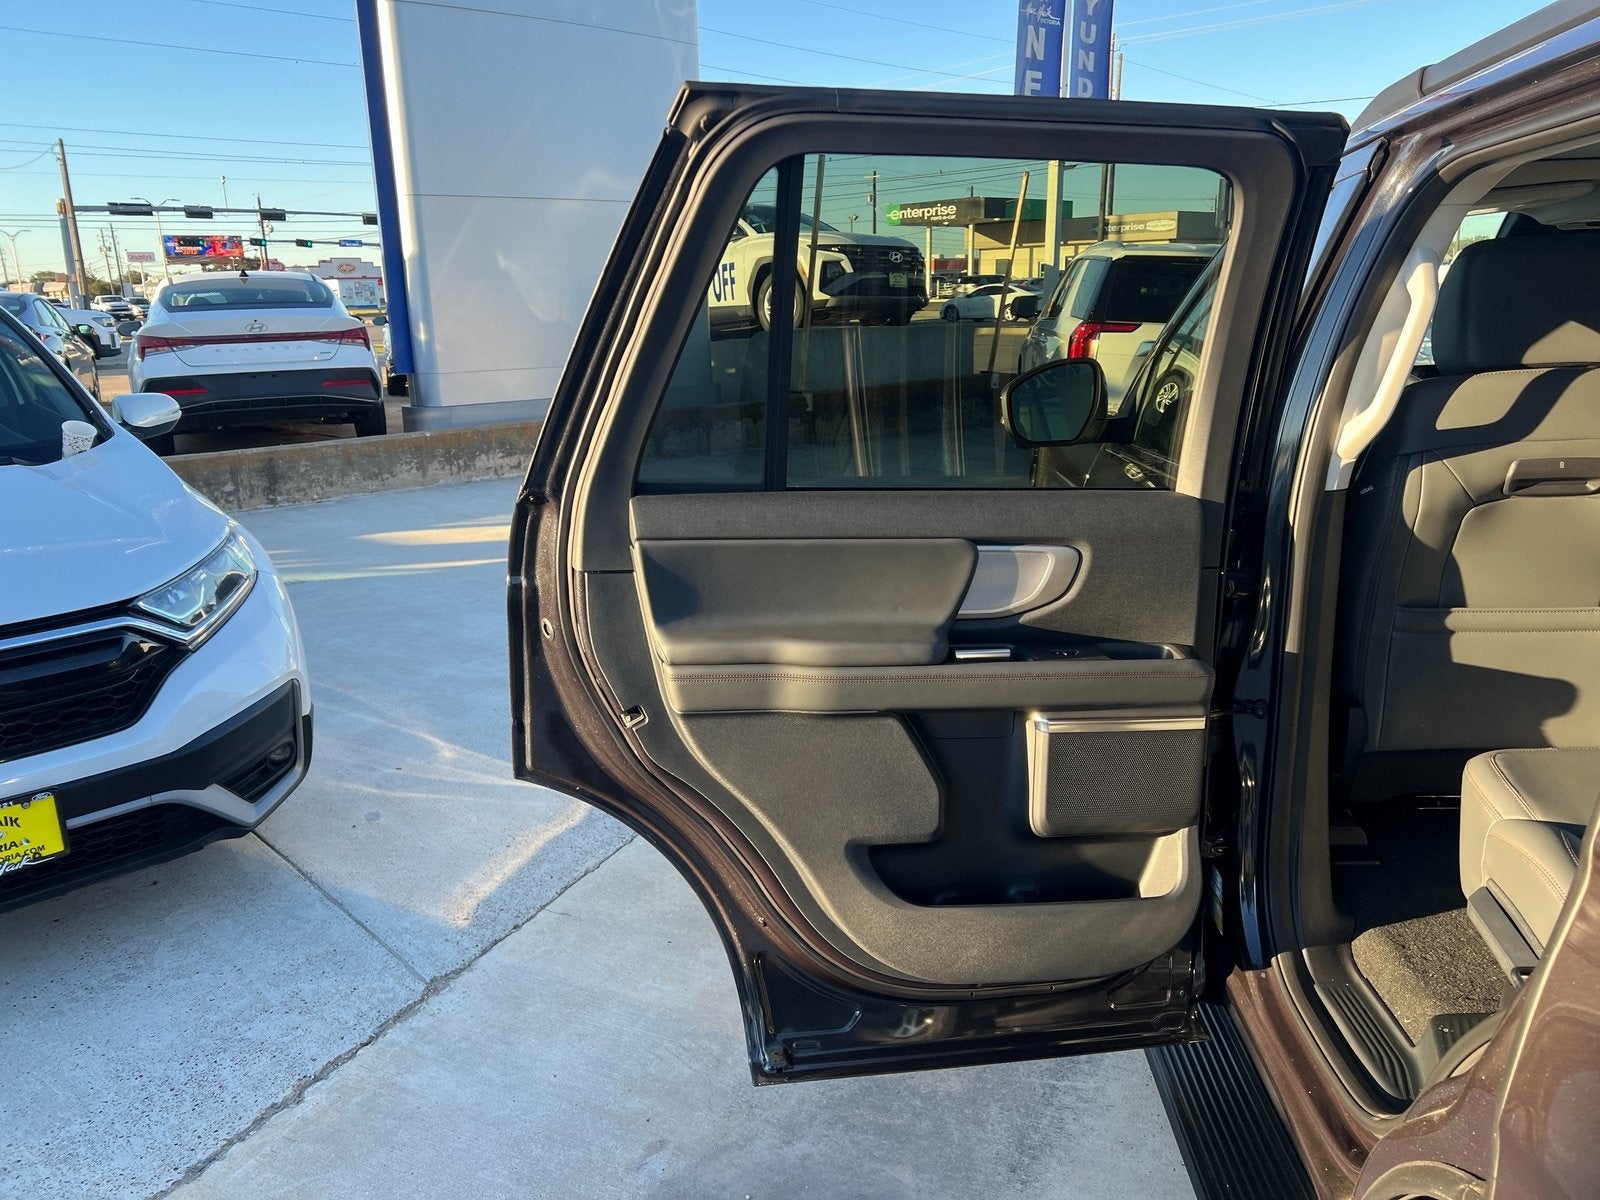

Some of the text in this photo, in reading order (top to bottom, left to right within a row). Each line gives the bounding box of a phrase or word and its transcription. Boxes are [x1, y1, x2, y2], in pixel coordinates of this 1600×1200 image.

[886, 203, 957, 220] enterprise
[713, 262, 735, 302] OFF
[215, 345, 304, 353] ELANTRA
